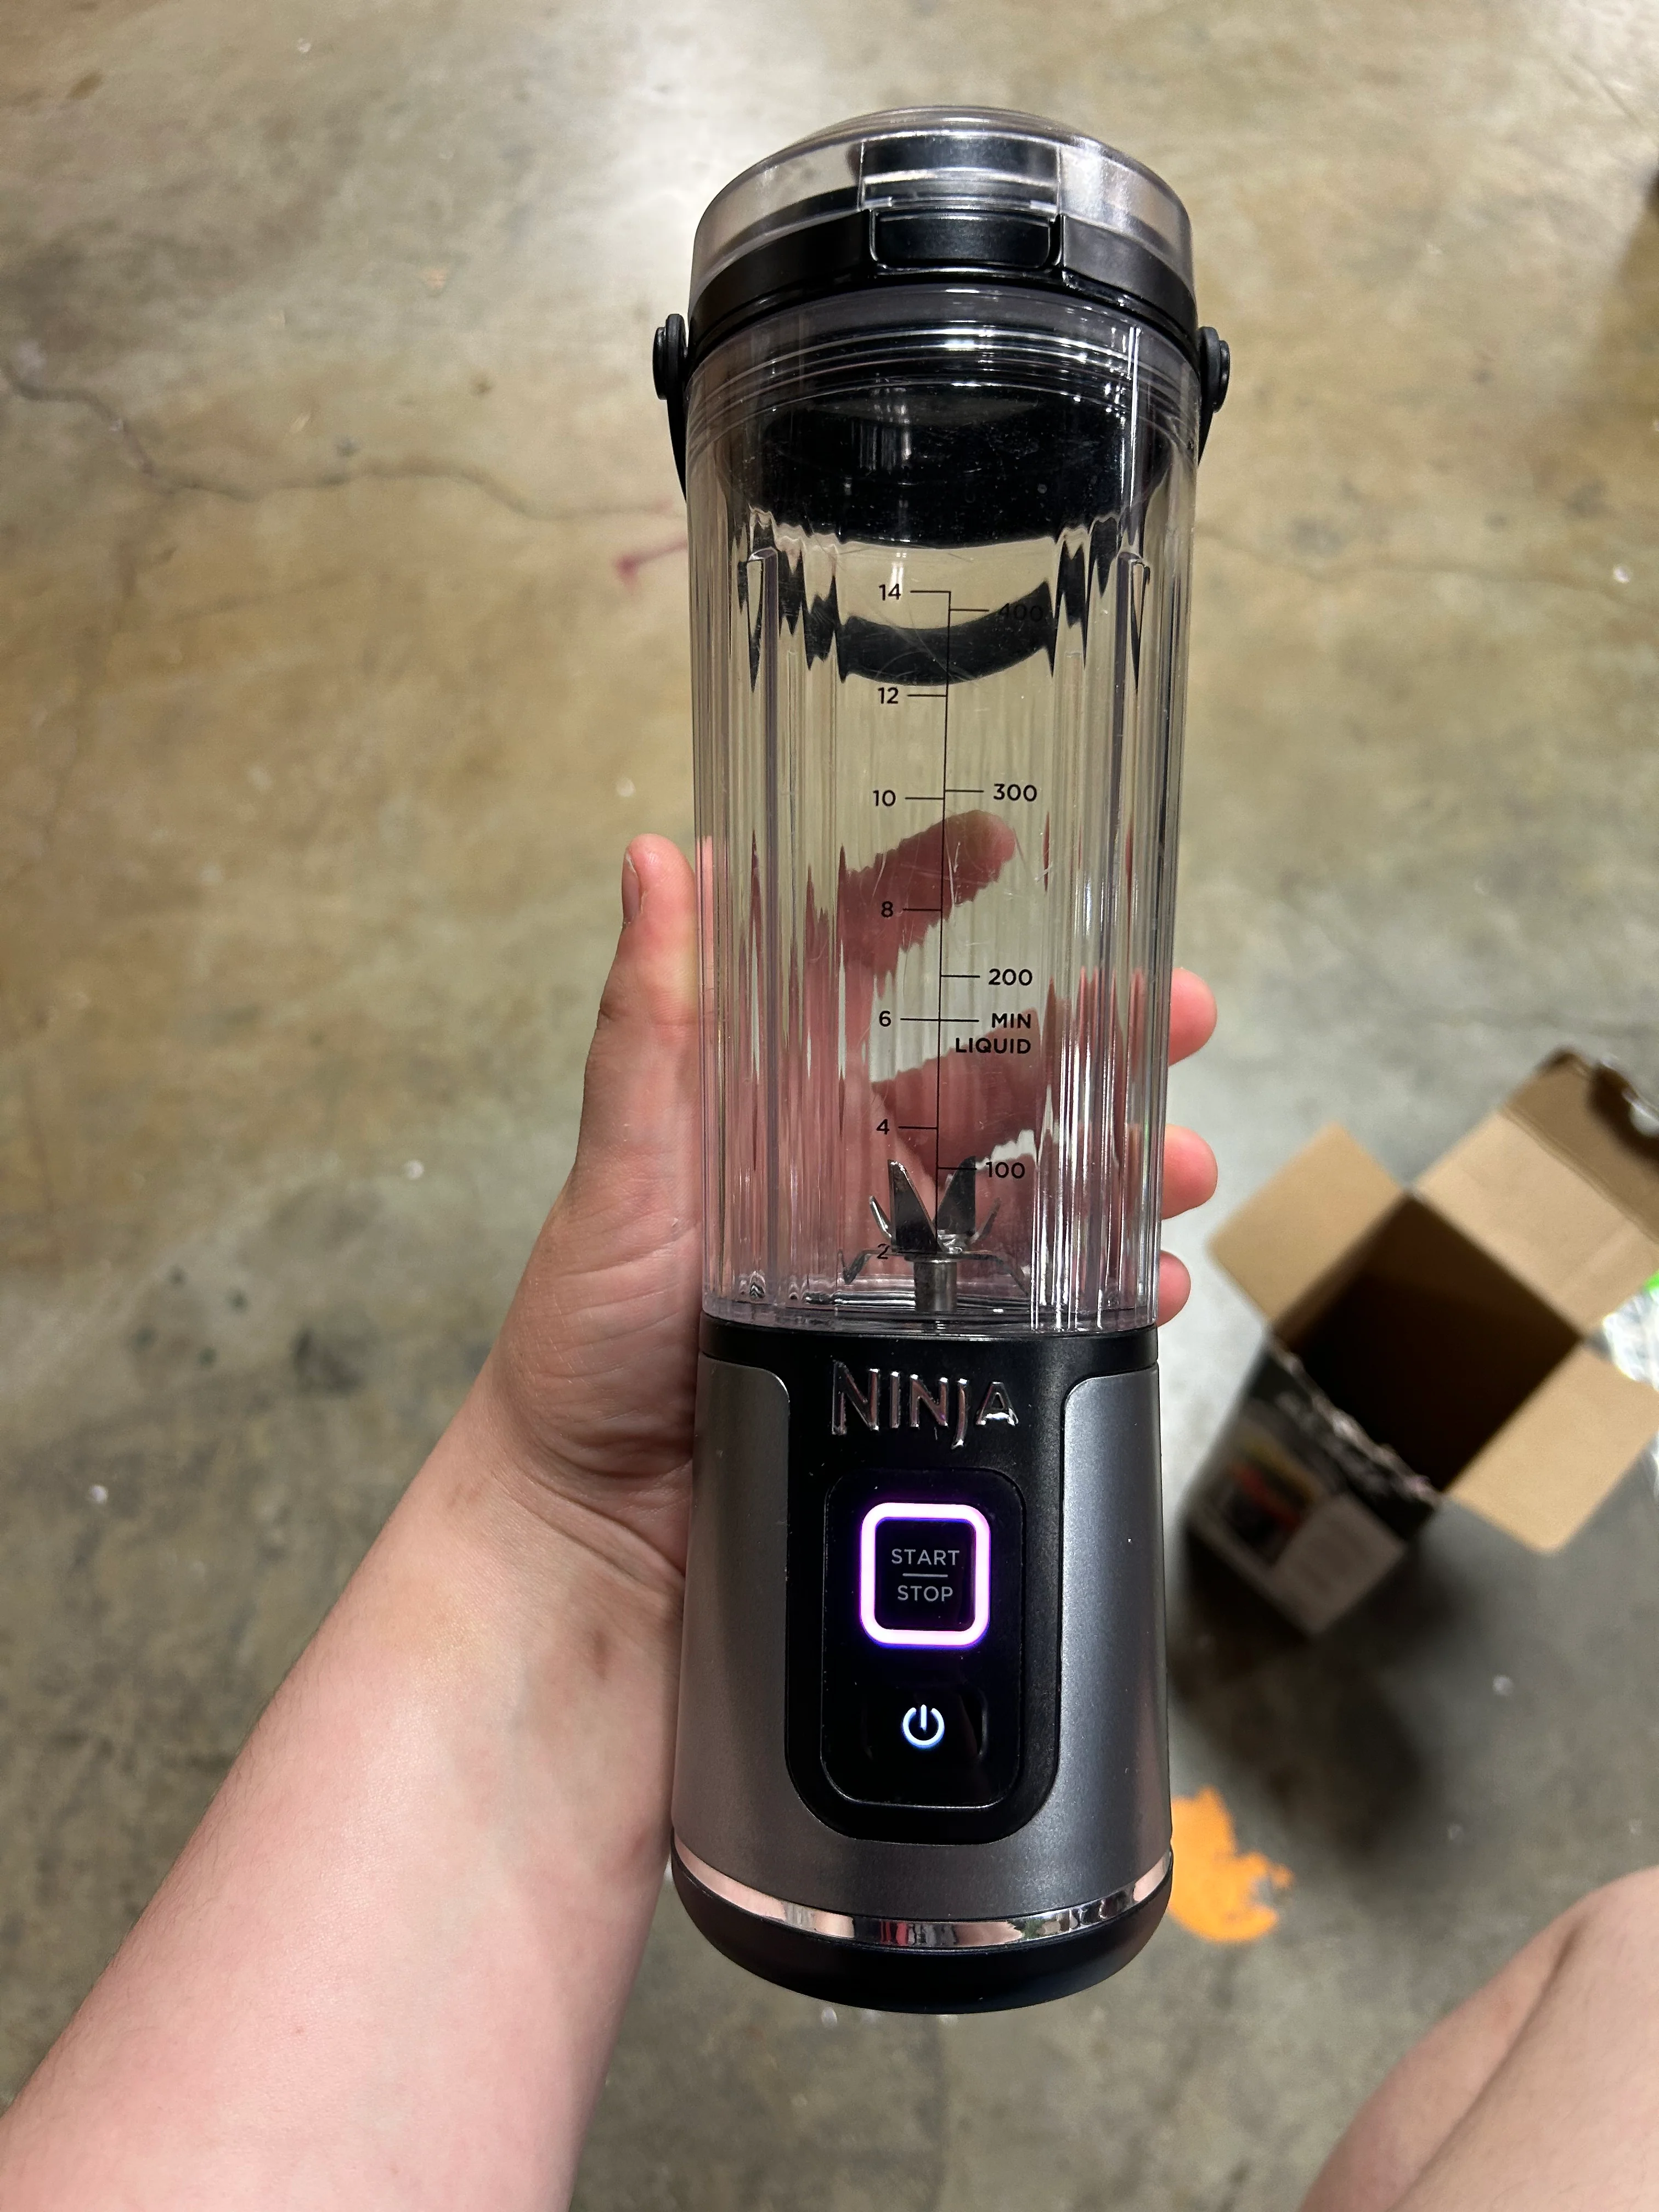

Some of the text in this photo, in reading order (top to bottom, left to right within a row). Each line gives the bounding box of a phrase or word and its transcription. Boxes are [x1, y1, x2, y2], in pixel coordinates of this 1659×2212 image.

[878, 584, 901, 601] 14
[998, 603, 1043, 622] 400
[878, 687, 899, 704] 12
[873, 789, 896, 806] 10
[993, 783, 1037, 802] 300
[881, 901, 894, 918] 8
[988, 969, 1032, 986] 200
[879, 1011, 891, 1027] 6
[992, 1013, 1032, 1029] MIN
[956, 1038, 1031, 1054] LIQUID
[876, 1119, 890, 1135] 4
[986, 1161, 1025, 1179] 100
[877, 1243, 889, 1260] 2
[831, 1359, 1019, 1449] NINJA
[891, 1549, 960, 1566] START
[897, 1585, 953, 1602] STOP
